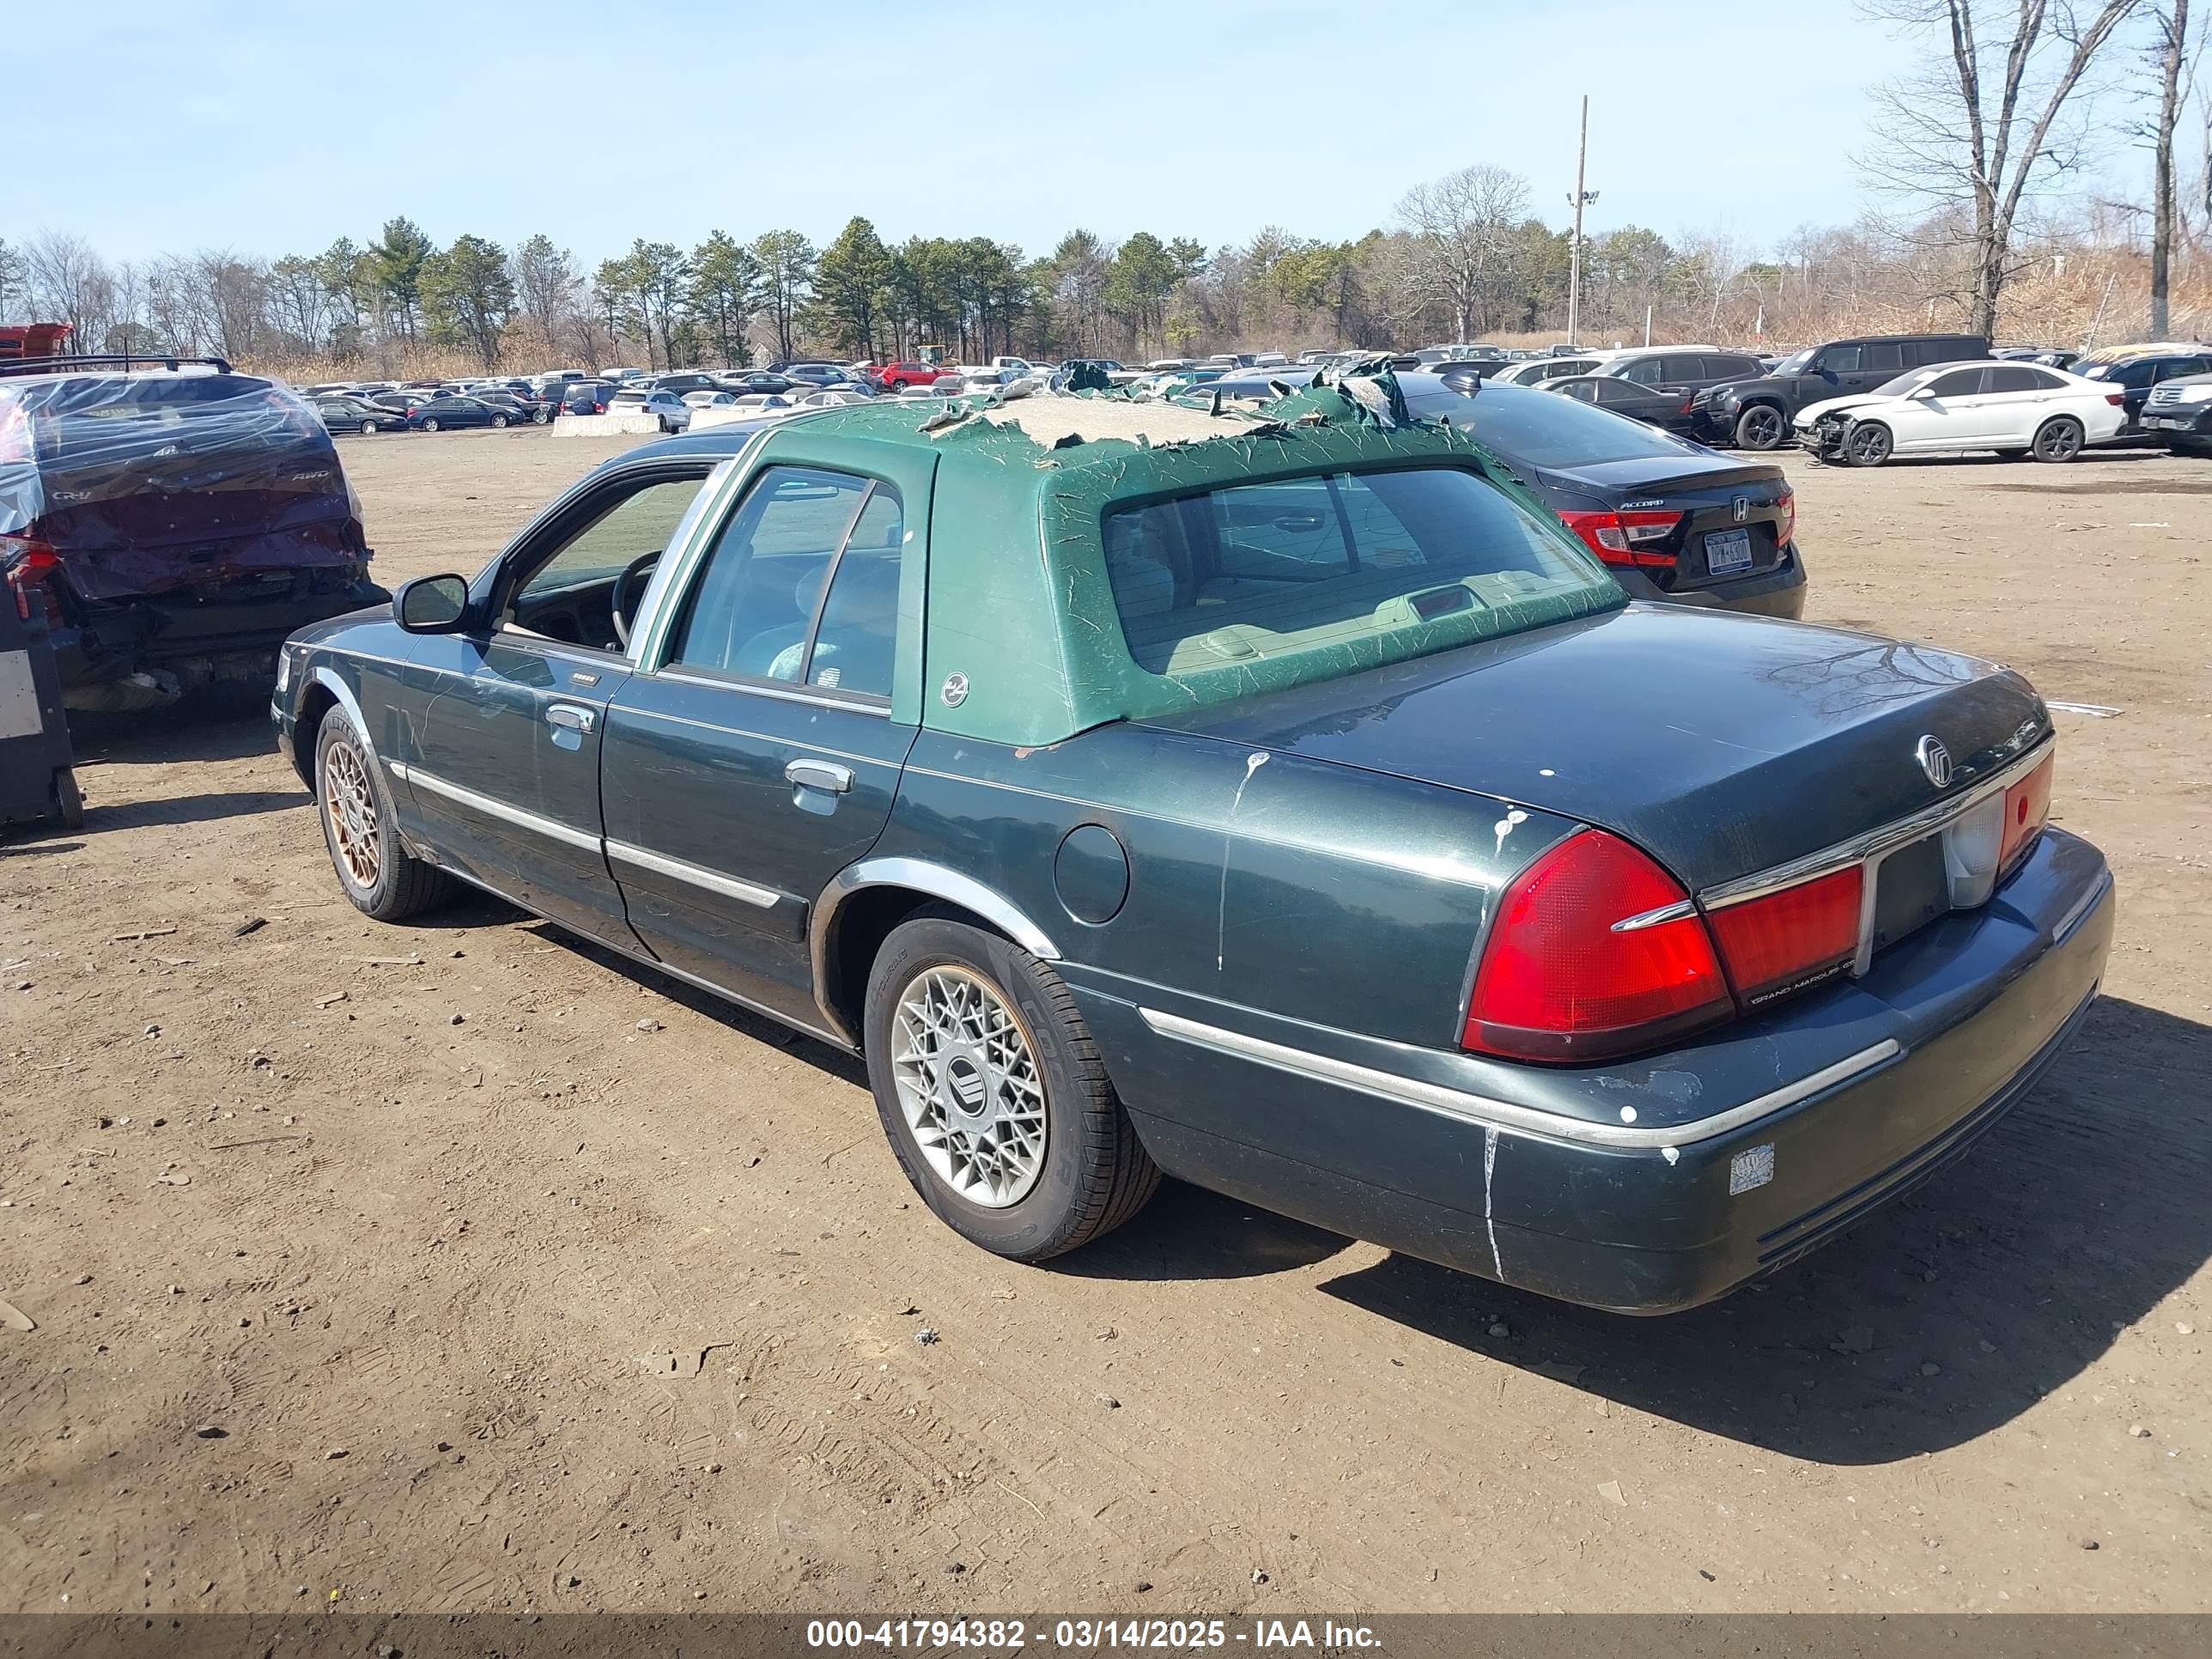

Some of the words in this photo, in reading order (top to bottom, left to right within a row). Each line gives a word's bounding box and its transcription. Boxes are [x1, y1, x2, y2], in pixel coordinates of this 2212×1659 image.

[291, 470, 329, 481] AWD
[52, 491, 92, 500] CR-V
[1620, 500, 1664, 509] ACCORD
[1752, 988, 1791, 1005] GRAND
[1795, 968, 1840, 989] MARQUIS
